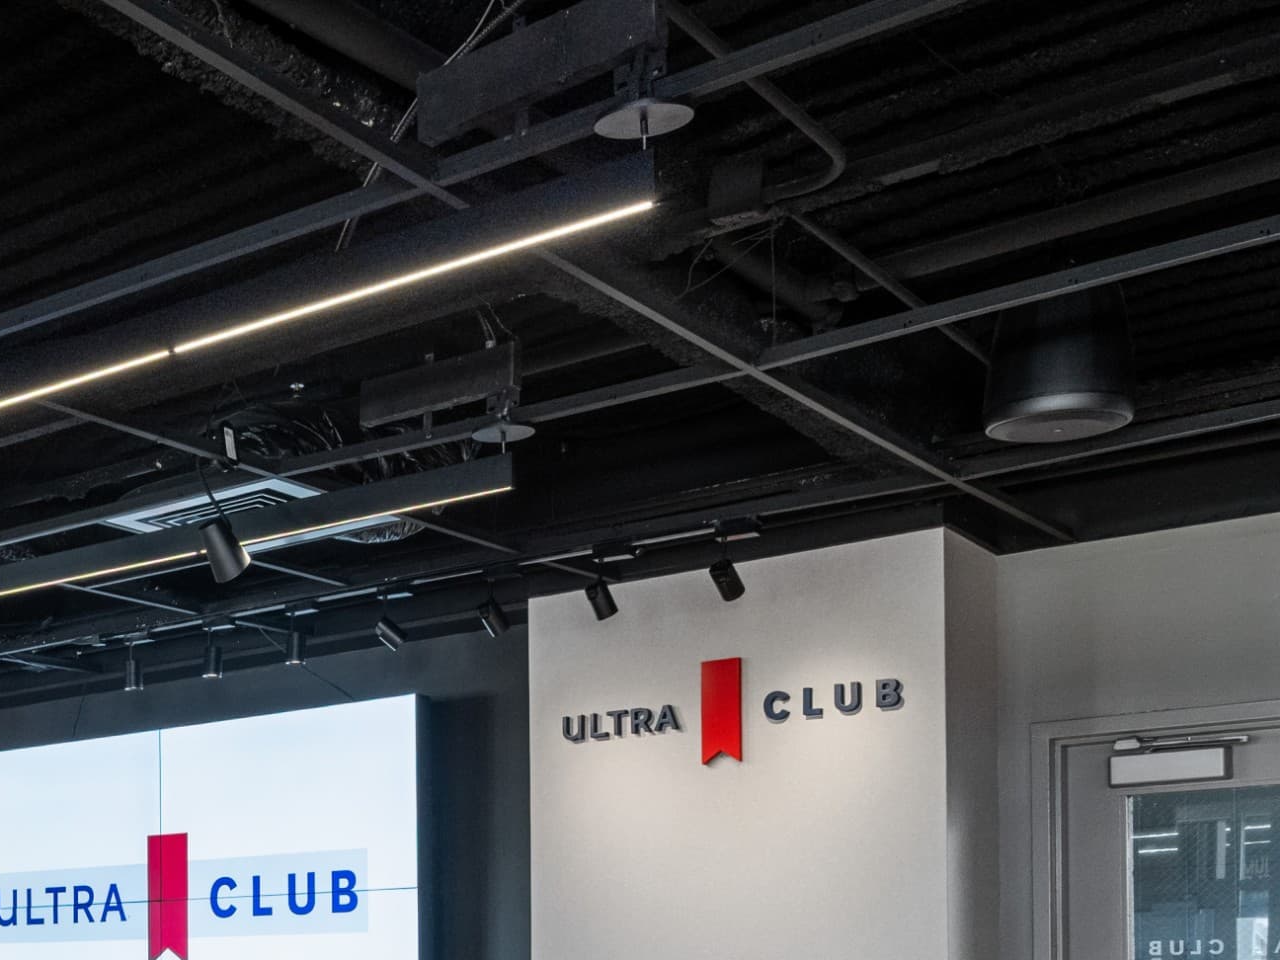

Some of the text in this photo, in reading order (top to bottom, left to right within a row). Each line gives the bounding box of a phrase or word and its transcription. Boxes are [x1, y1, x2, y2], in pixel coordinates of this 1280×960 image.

[562, 679, 904, 743] ULTRA CLUB
[209, 869, 358, 919] CLUB
